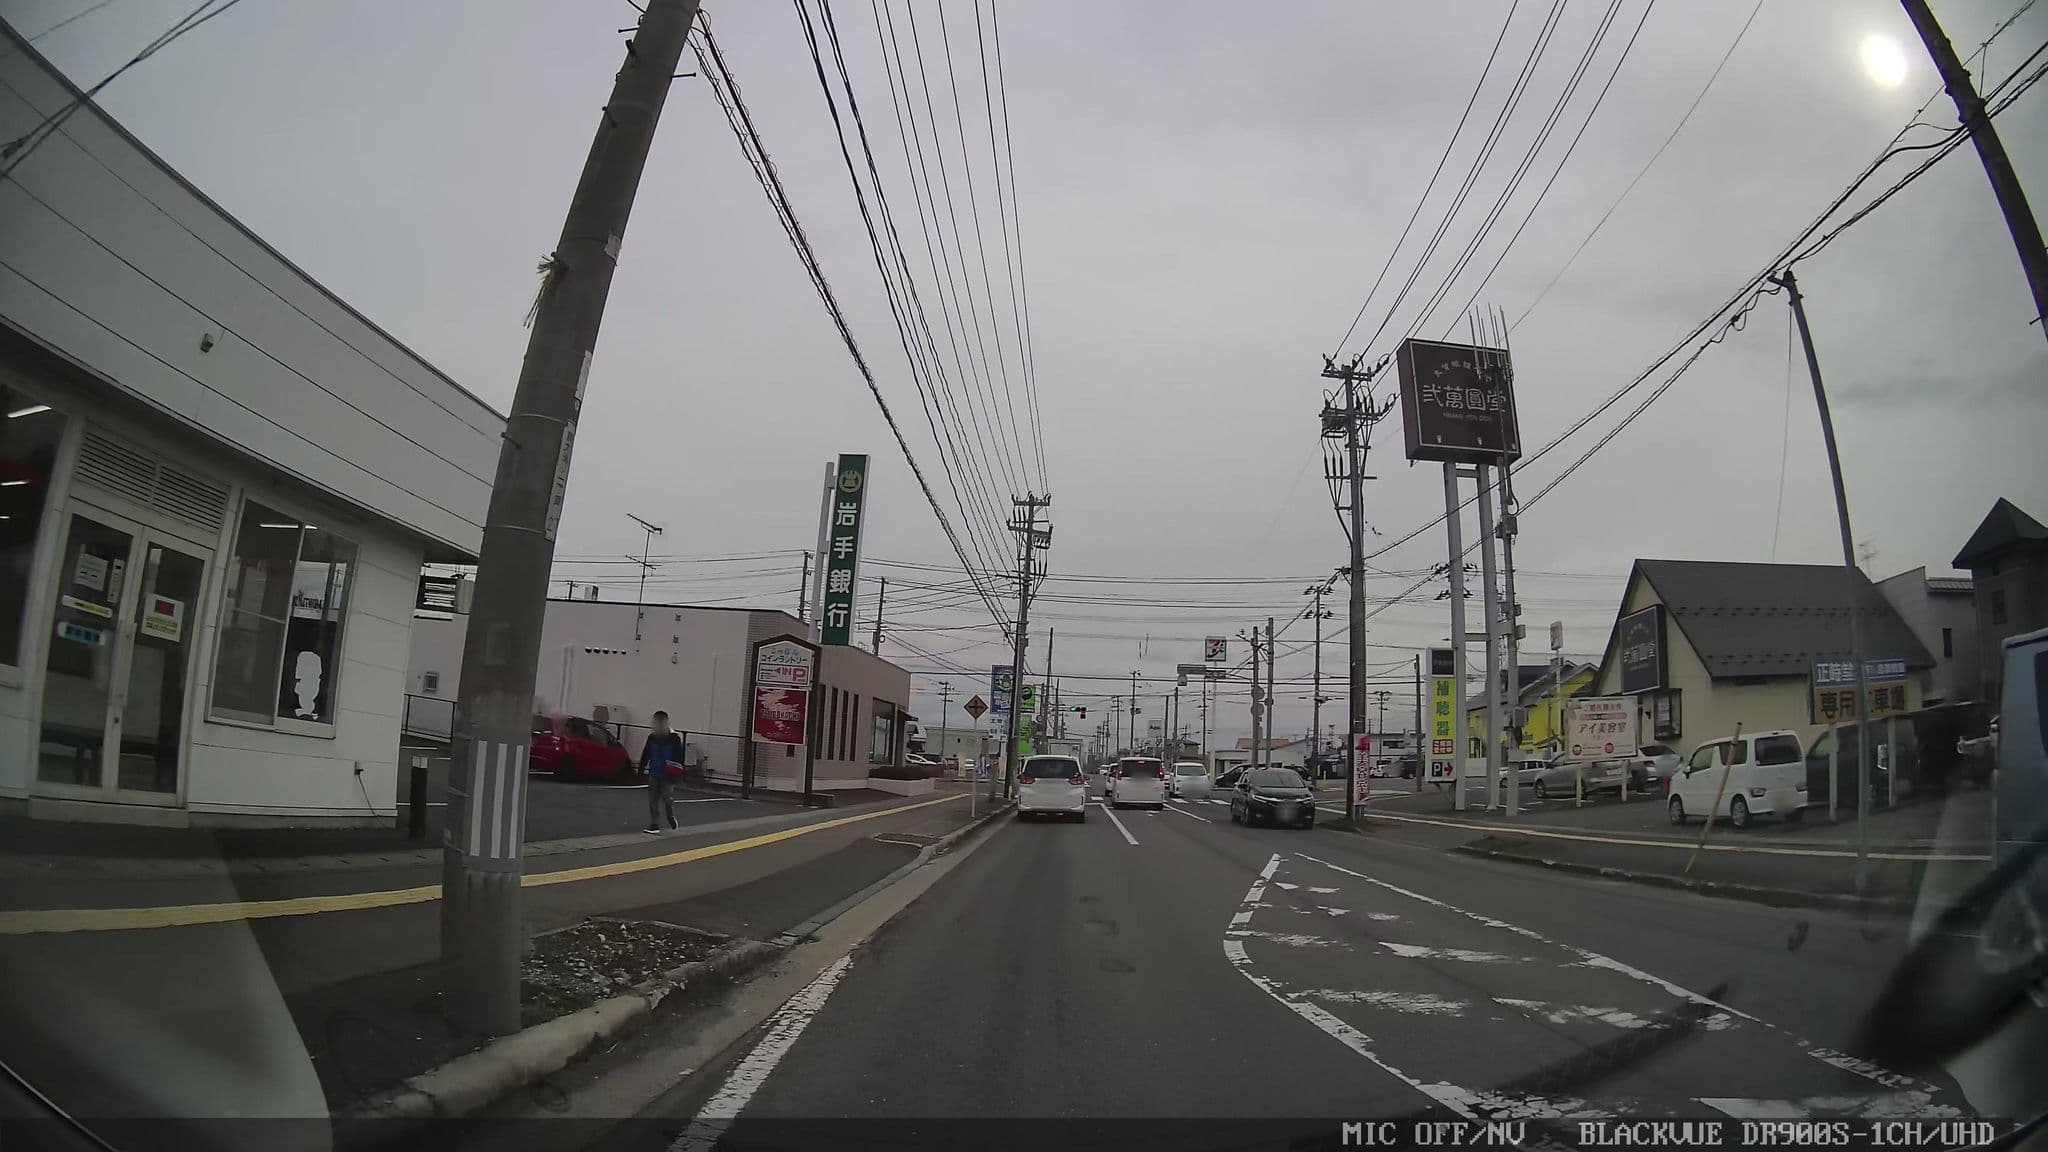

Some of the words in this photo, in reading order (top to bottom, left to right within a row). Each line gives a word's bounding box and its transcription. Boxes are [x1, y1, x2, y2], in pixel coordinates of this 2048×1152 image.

[827, 501, 857, 628] 岩手銀行
[1433, 762, 1442, 776] P
